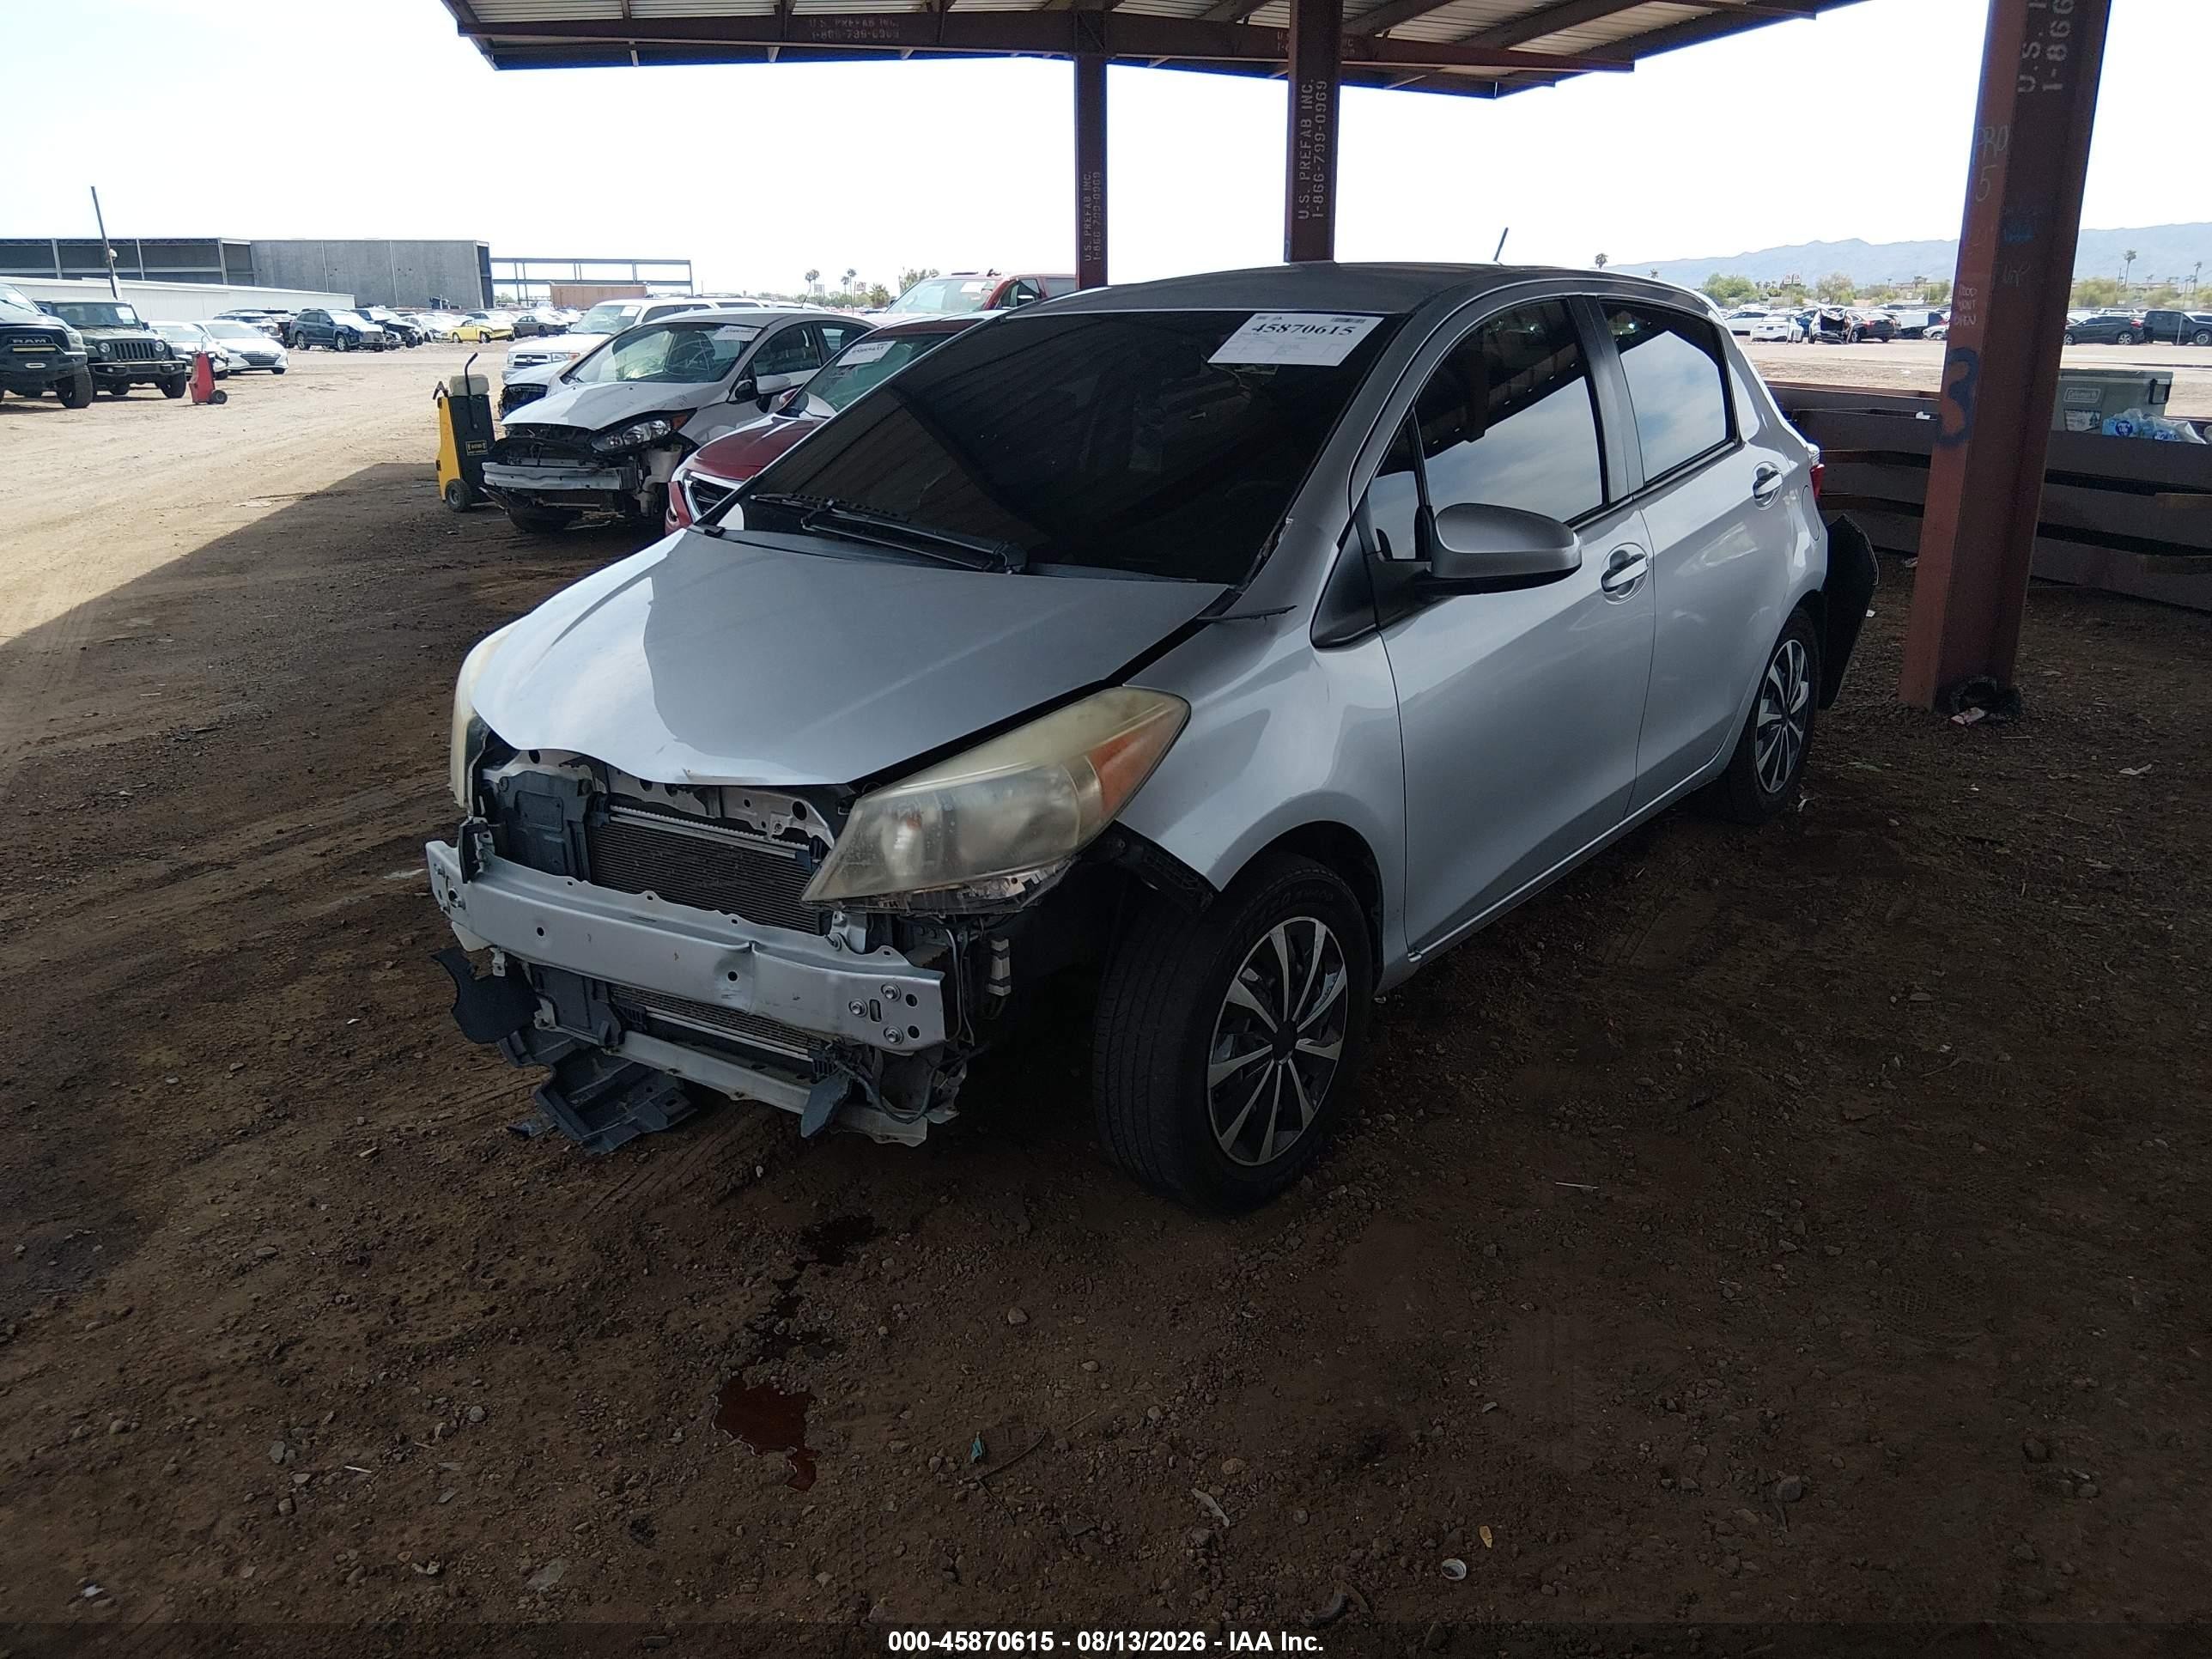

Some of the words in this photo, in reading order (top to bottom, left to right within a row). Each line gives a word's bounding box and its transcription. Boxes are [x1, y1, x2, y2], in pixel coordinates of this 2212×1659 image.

[2017, 31, 2044, 93] U.S.
[1301, 78, 1314, 110] INC.
[1299, 118, 1312, 181] PREFAB
[1312, 80, 1328, 218] 1-866-799-0969
[1297, 190, 1310, 220] U.S.
[1976, 165, 1998, 202] 5
[1252, 323, 1358, 336] 45870615
[1936, 347, 1978, 447] 3
